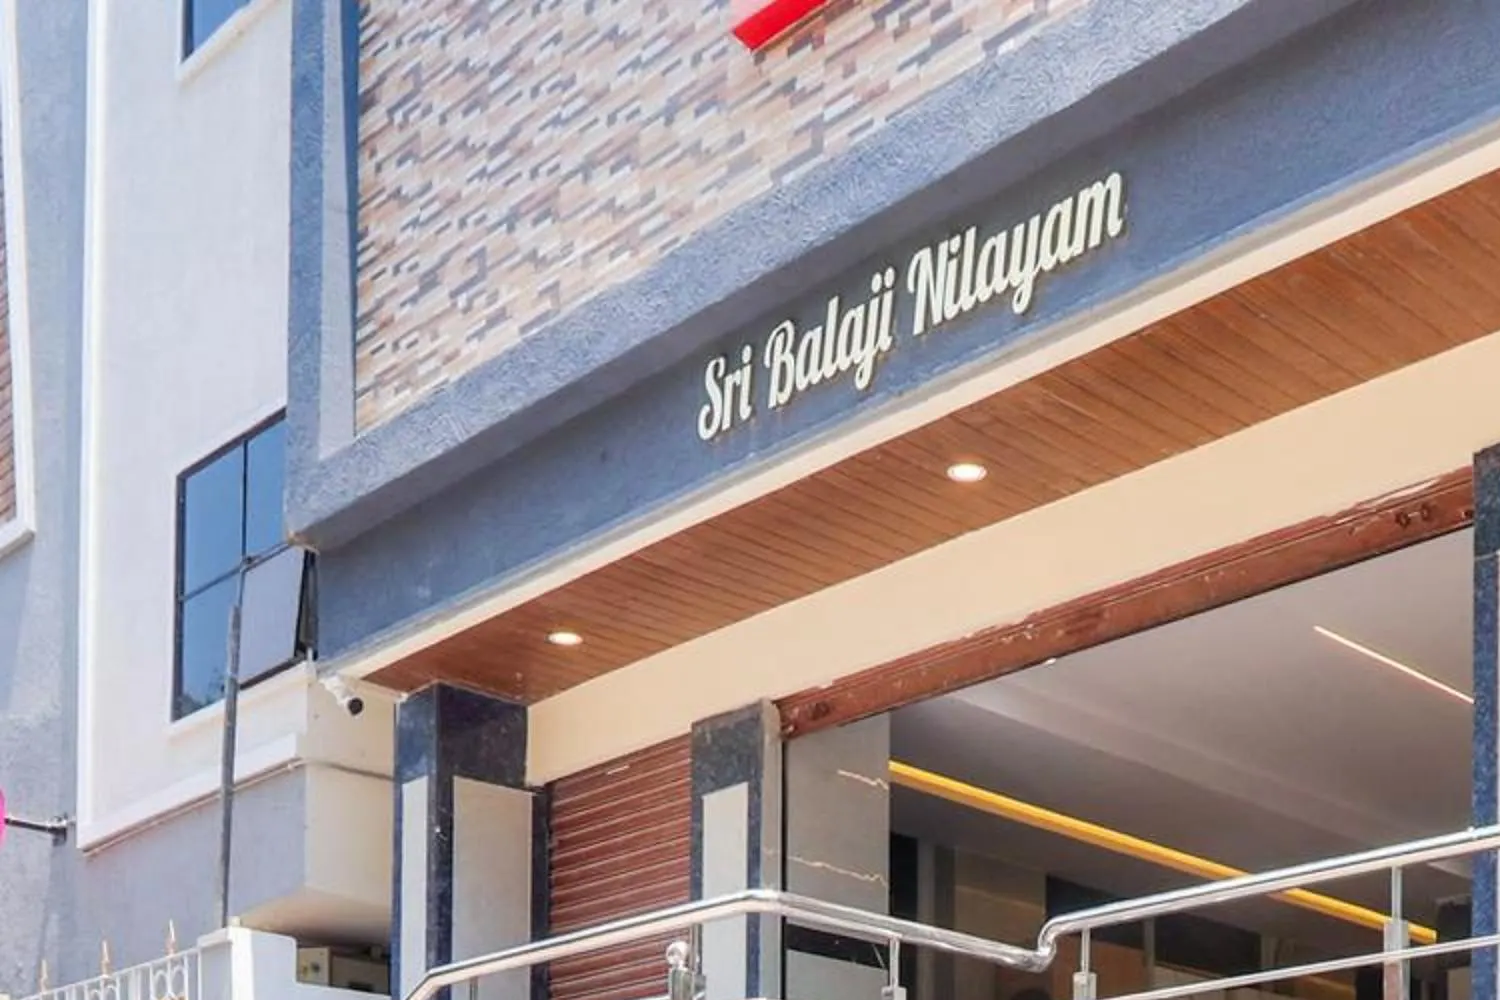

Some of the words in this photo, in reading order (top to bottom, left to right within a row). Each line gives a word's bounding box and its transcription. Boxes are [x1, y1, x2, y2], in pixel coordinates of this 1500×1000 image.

[698, 345, 753, 440] Sri
[764, 267, 896, 411] Balaji
[907, 172, 1123, 335] Nilayam
